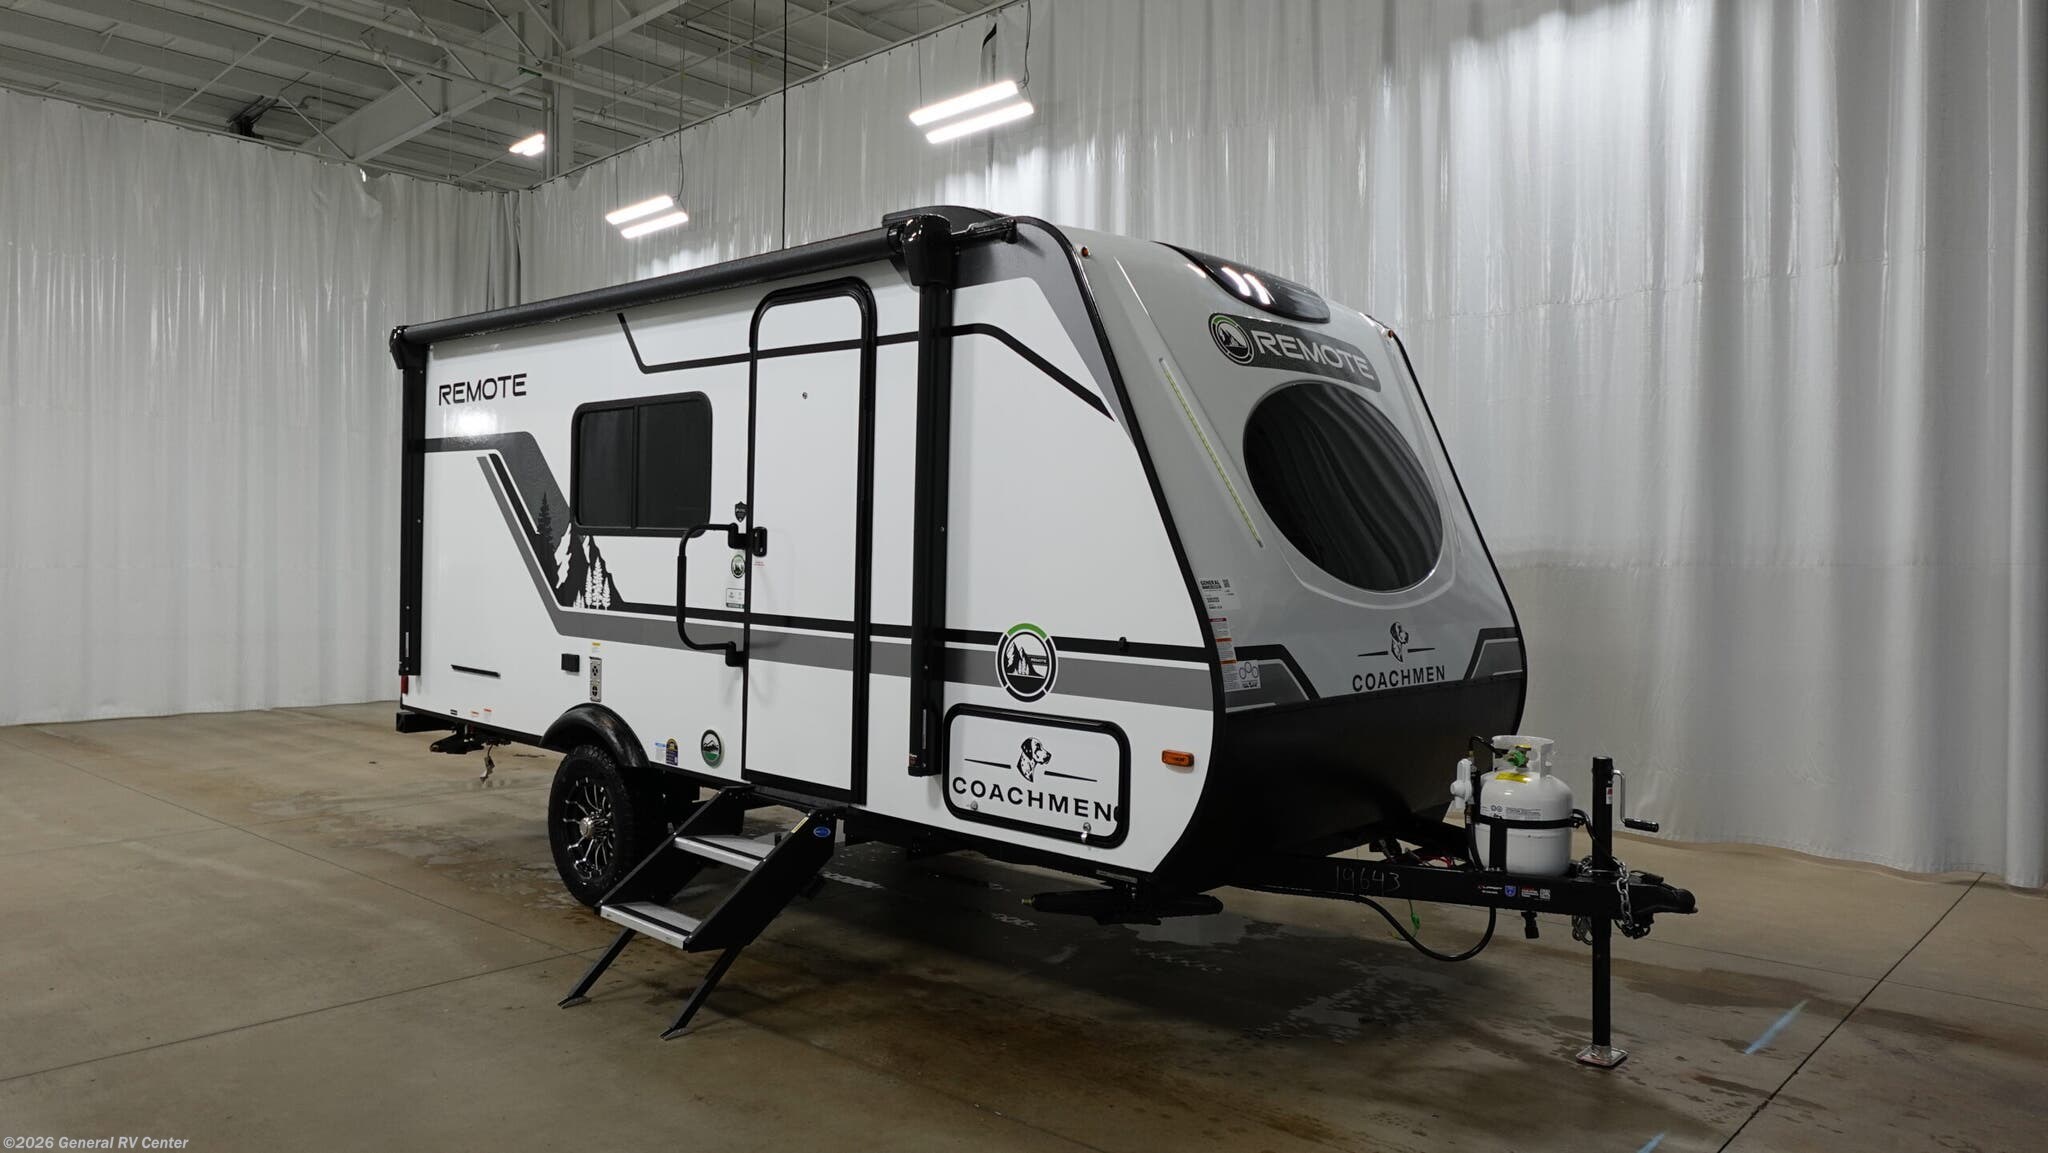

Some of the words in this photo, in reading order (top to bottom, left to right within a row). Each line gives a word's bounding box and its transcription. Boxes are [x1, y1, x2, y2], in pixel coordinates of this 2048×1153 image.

[1250, 329, 1375, 380] REMOTE
[439, 373, 527, 406] REMOTE
[1352, 665, 1445, 692] COACHMEN
[952, 776, 1112, 822] COACHMEN
[1336, 864, 1401, 893] 19643
